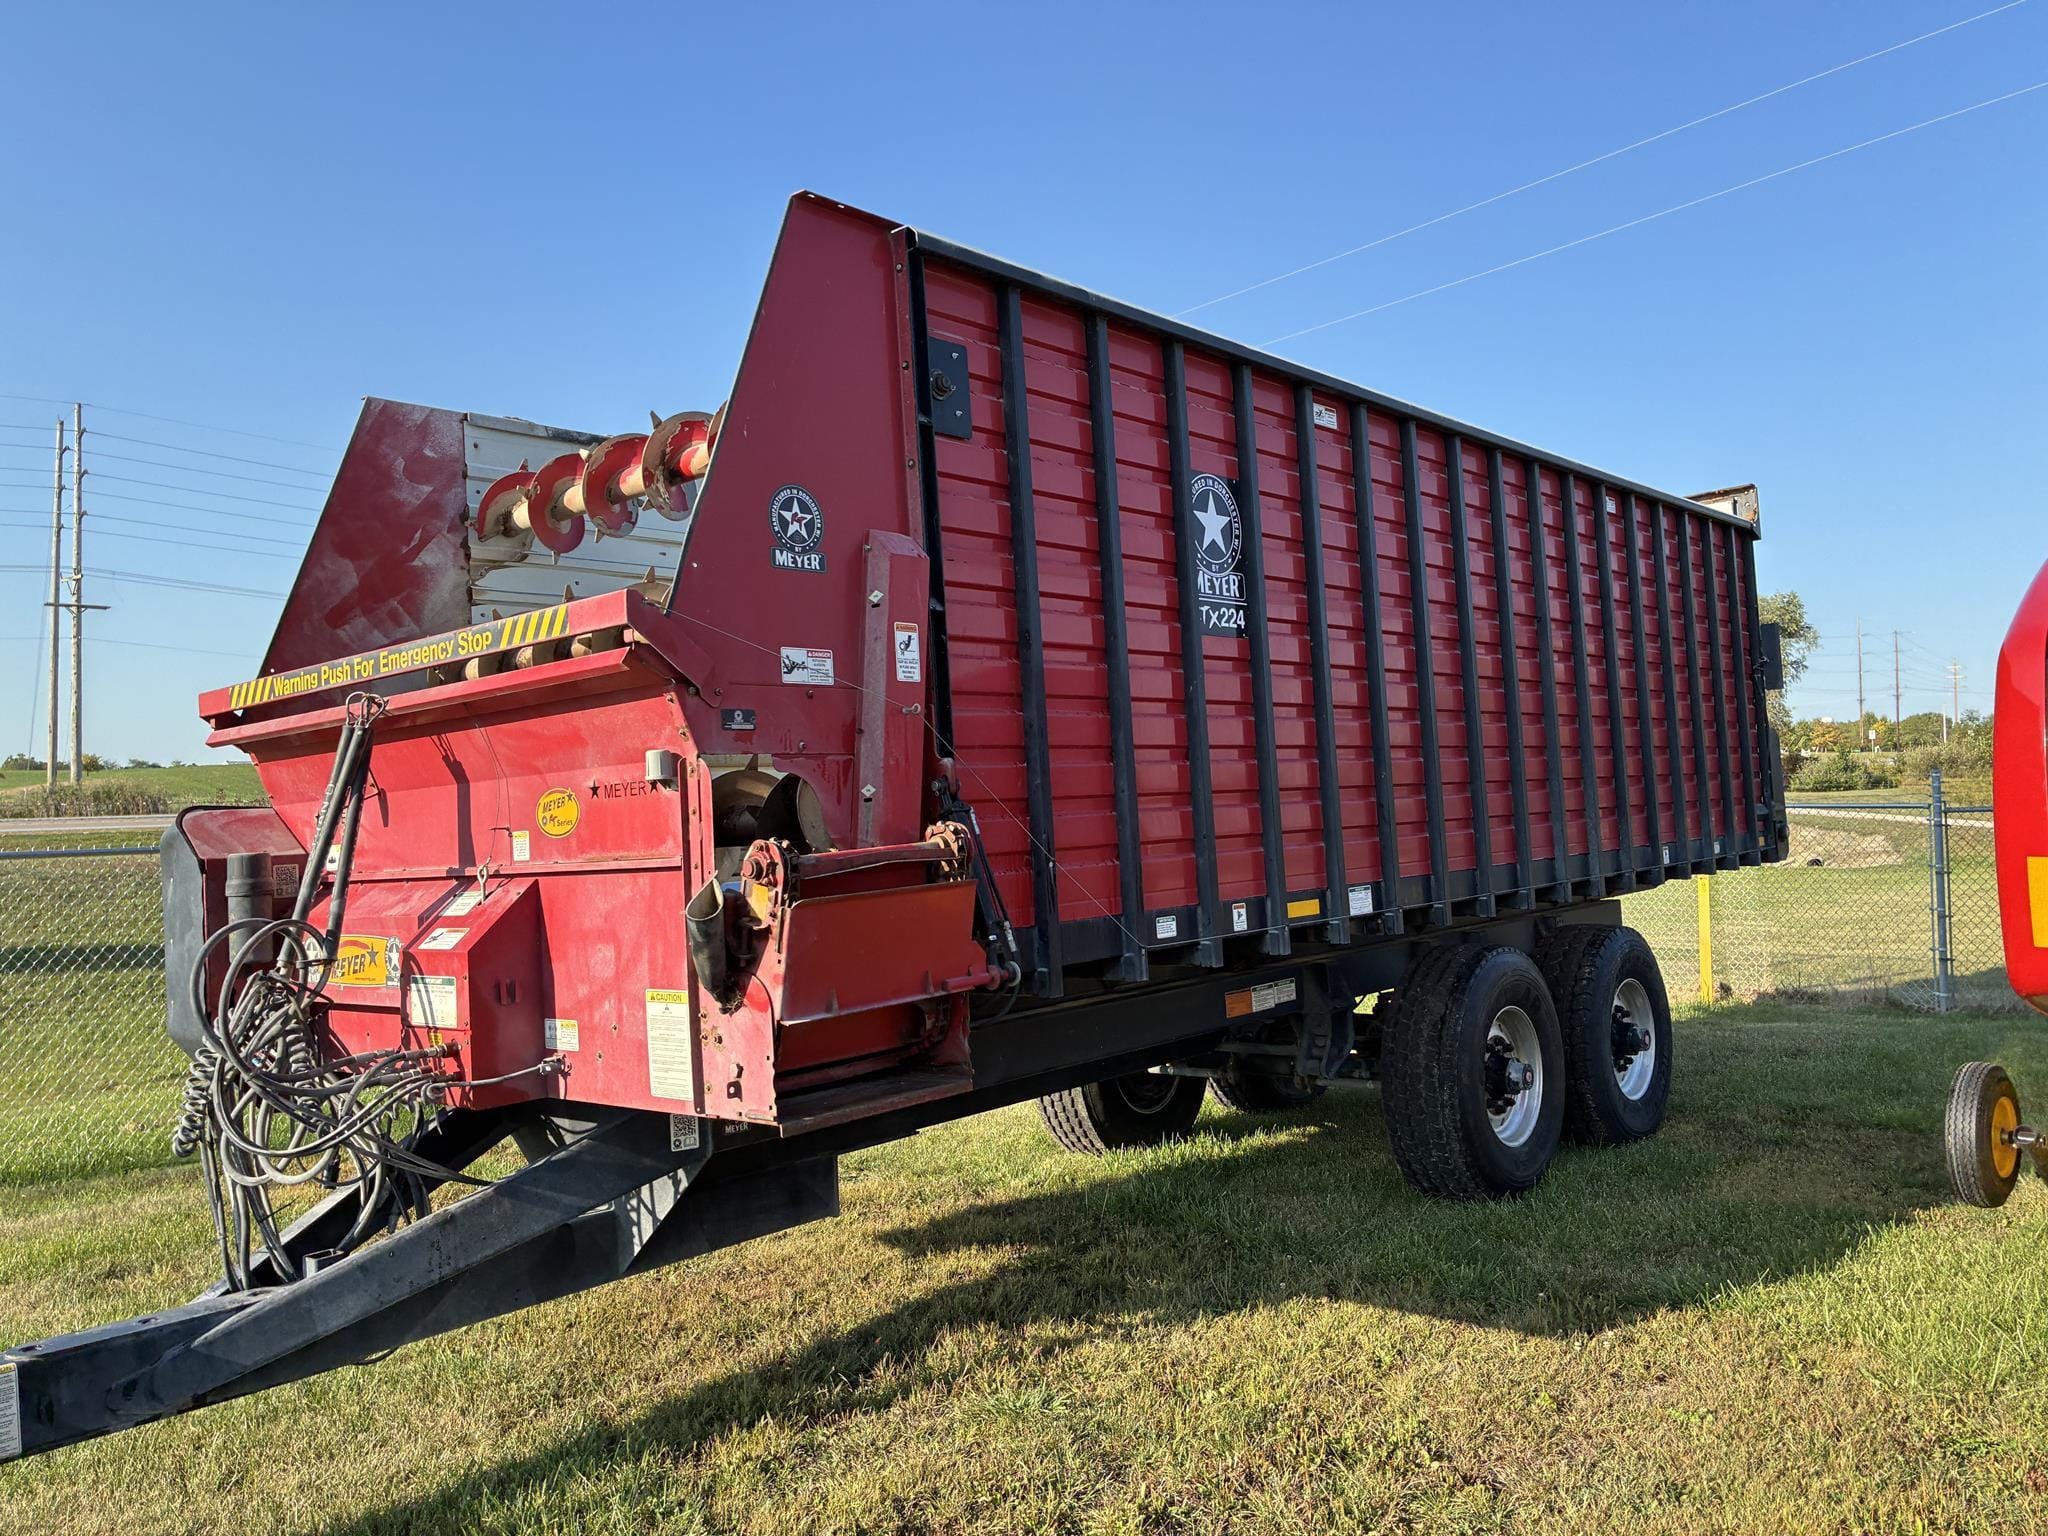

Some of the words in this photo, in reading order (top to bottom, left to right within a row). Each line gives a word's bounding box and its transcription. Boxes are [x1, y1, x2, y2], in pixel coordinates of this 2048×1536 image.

[771, 488, 791, 532] MANUFACTURED
[798, 490, 821, 528] DORCHESTER
[1214, 481, 1241, 536] DORCHESTER
[775, 549, 821, 570] MEYER
[1199, 605, 1246, 629] TX224
[273, 673, 318, 697] Warning
[320, 663, 350, 685] Push
[354, 656, 374, 678] For
[380, 639, 454, 672] Emergency
[457, 629, 492, 654] Stop
[604, 780, 647, 799] MEYER
[542, 796, 566, 814] MEYER
[556, 819, 573, 827] Series
[656, 993, 683, 1002] CAUTION
[725, 1122, 749, 1134] MEYER
